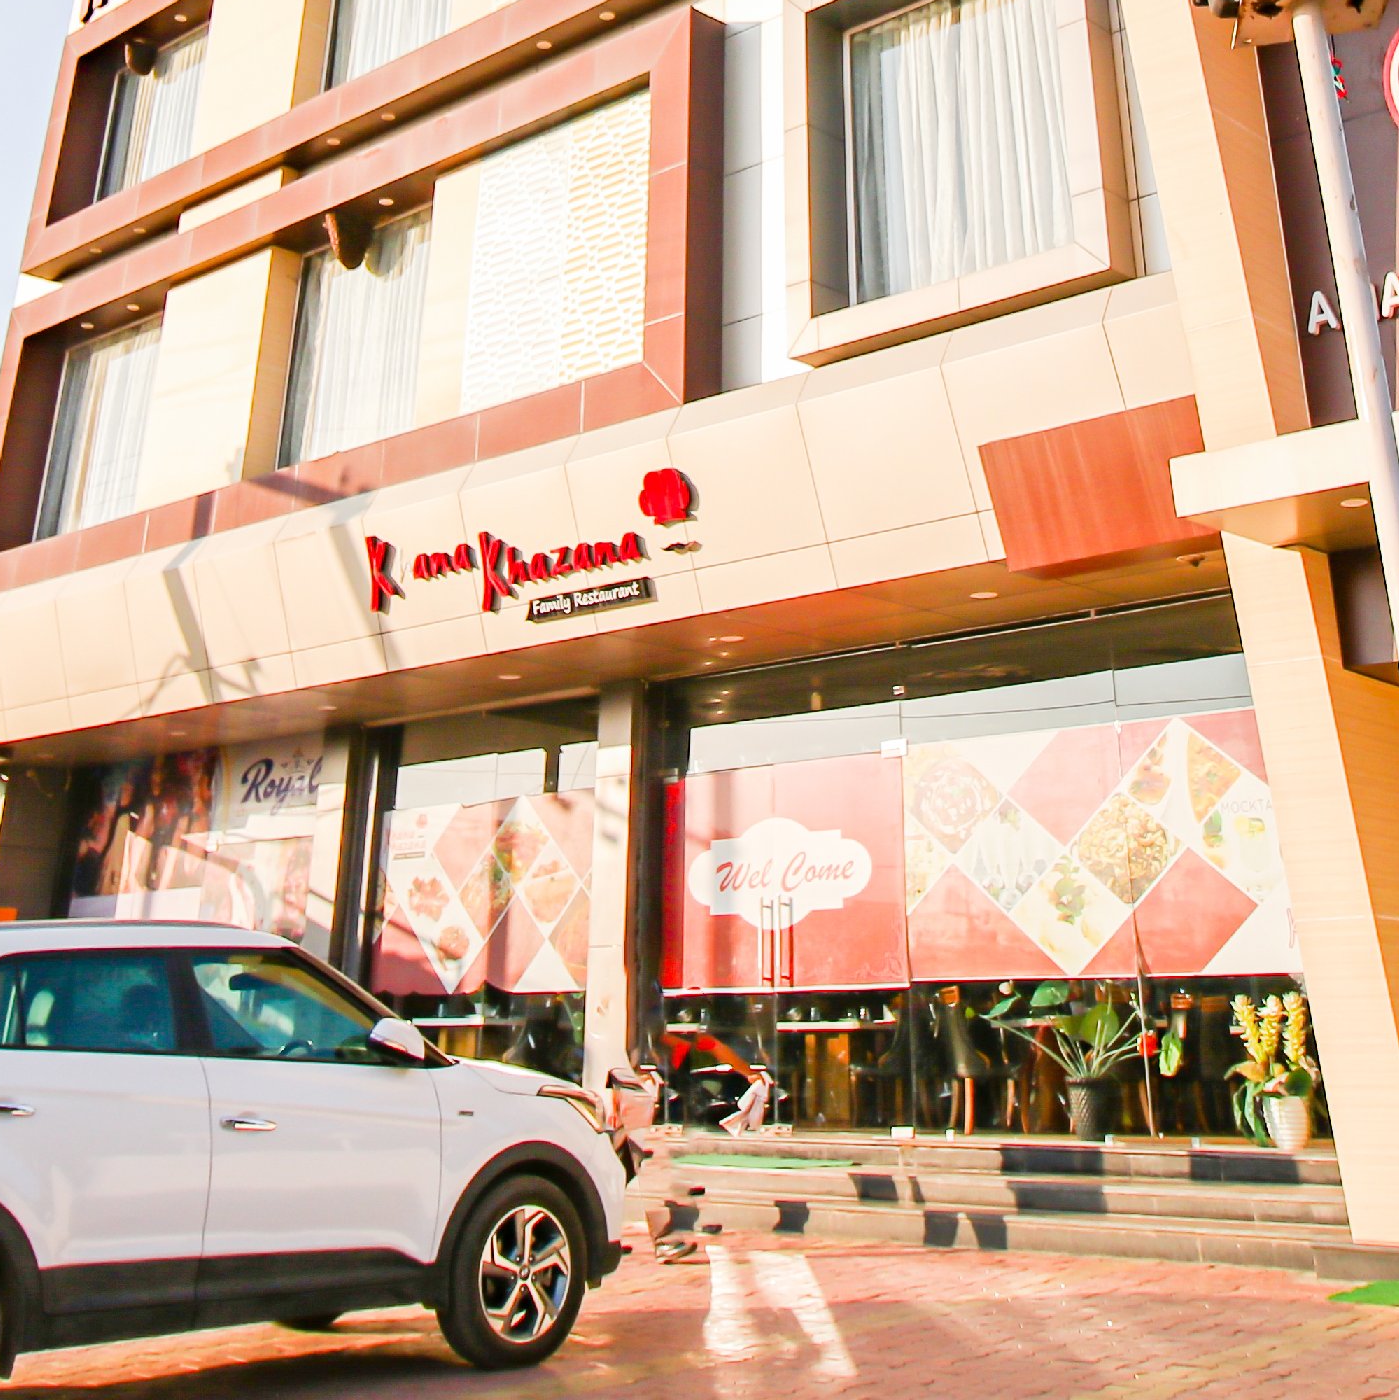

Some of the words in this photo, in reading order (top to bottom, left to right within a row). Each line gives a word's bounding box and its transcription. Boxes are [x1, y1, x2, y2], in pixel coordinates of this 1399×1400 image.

[478, 531, 644, 613] Khazana
[532, 594, 572, 615] Family
[573, 581, 640, 608] Restaurant
